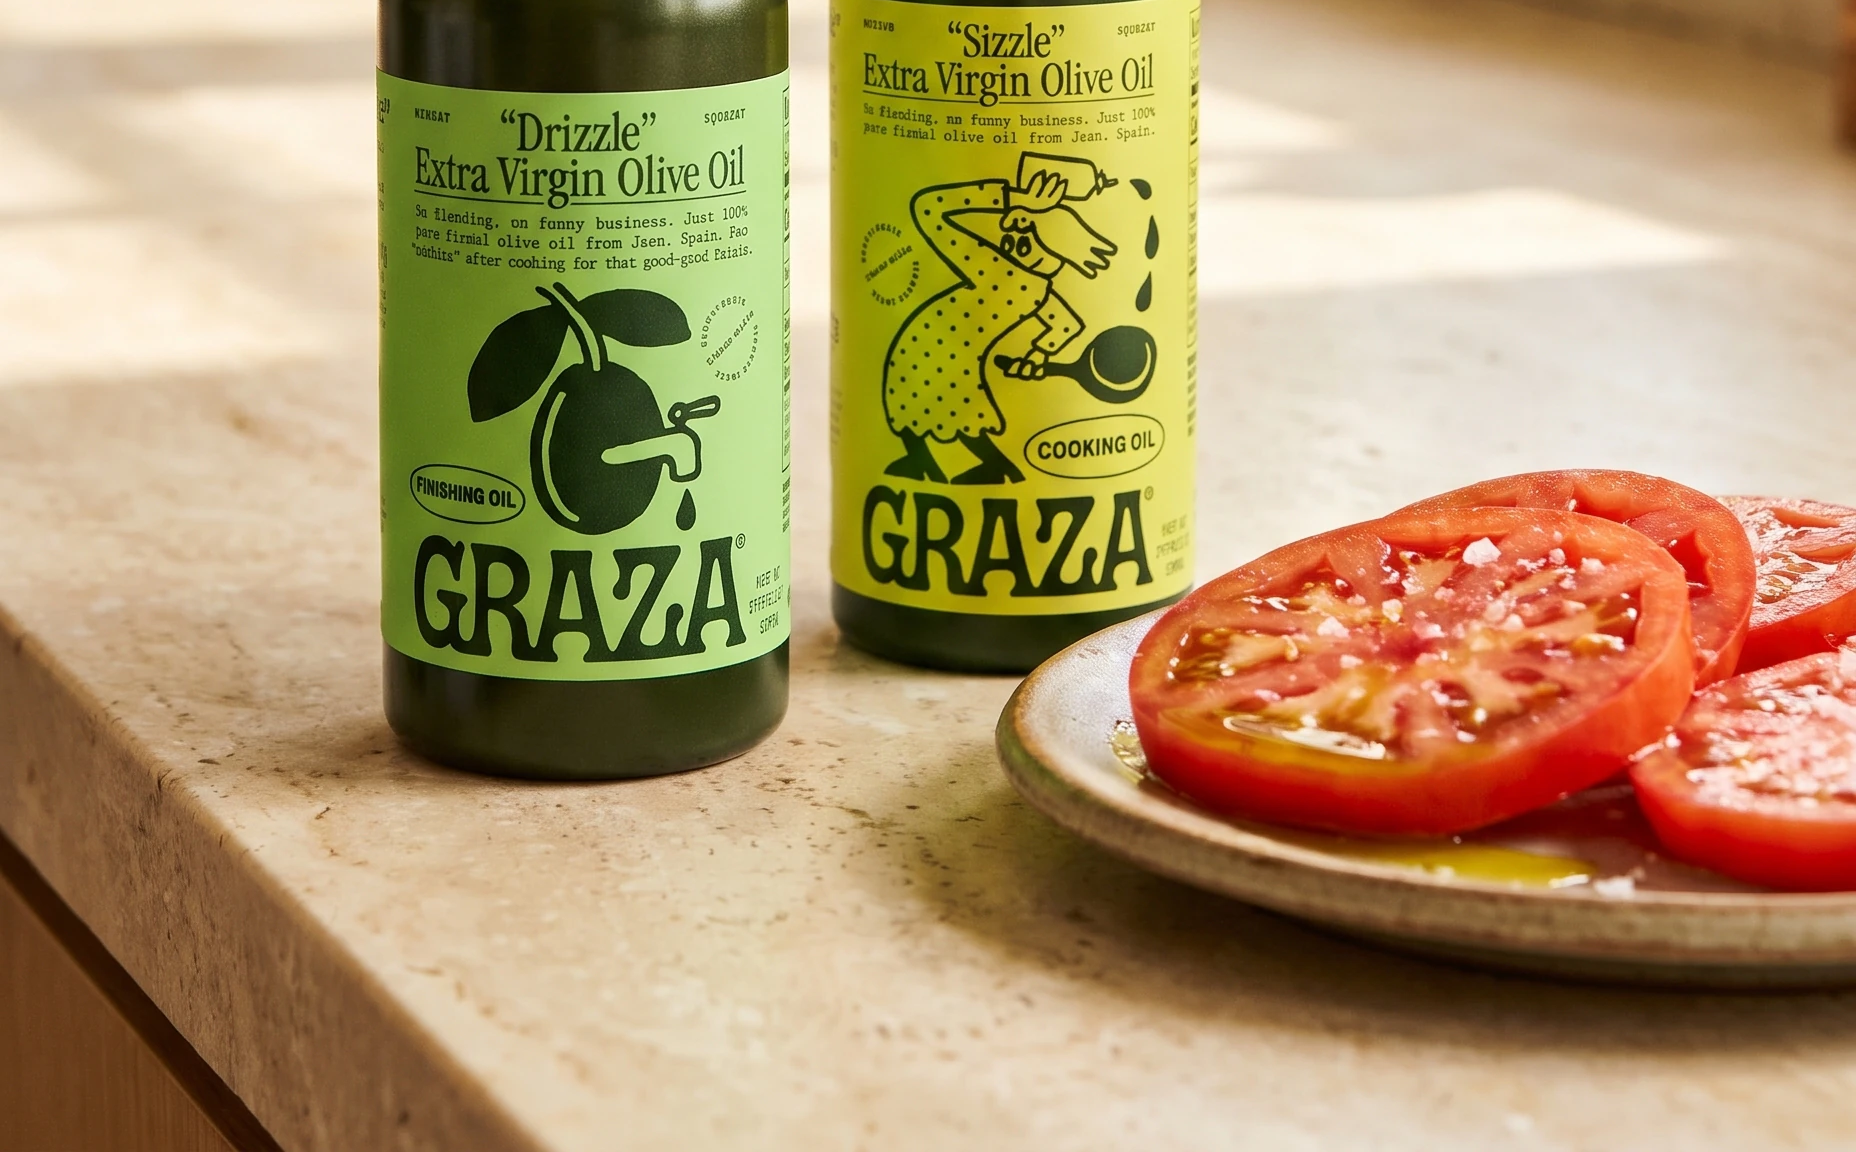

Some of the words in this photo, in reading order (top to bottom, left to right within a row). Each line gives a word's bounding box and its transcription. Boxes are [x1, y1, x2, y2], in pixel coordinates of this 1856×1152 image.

[948, 21, 1065, 58] “Sizzle”
[863, 52, 929, 94] Extra
[935, 61, 1031, 107] Virgin
[1041, 59, 1113, 97] Olive
[1121, 52, 1154, 92] Oil
[501, 108, 656, 152] “Drizzle”
[971, 114, 1011, 129] funny
[1020, 114, 1088, 127] business.
[1097, 111, 1125, 124] Just
[1132, 106, 1156, 121] 100%
[944, 129, 984, 143] olive
[993, 130, 1018, 144] oil
[1029, 131, 1062, 144] from
[1071, 131, 1108, 143] Jean.
[1116, 125, 1155, 142] Spain.
[415, 145, 490, 193] Extra
[496, 156, 606, 209] Virgin
[618, 153, 700, 197] Olive
[708, 144, 744, 189] Oil
[596, 215, 673, 230] business.
[683, 211, 715, 225] Just
[722, 205, 748, 221] 100%
[415, 225, 440, 240] pare
[497, 234, 540, 249] olive
[548, 236, 575, 250] oil
[586, 236, 622, 249] from
[680, 230, 722, 247] Spain.
[465, 252, 502, 267] after
[573, 256, 597, 270] for
[606, 256, 637, 269] that
[1037, 436, 1126, 460] COOKING
[1131, 430, 1155, 450] OIL
[416, 476, 484, 505] FINISHING
[489, 489, 516, 508] OIL
[862, 485, 1153, 597] GRAZA
[414, 535, 747, 663] GRAZA
